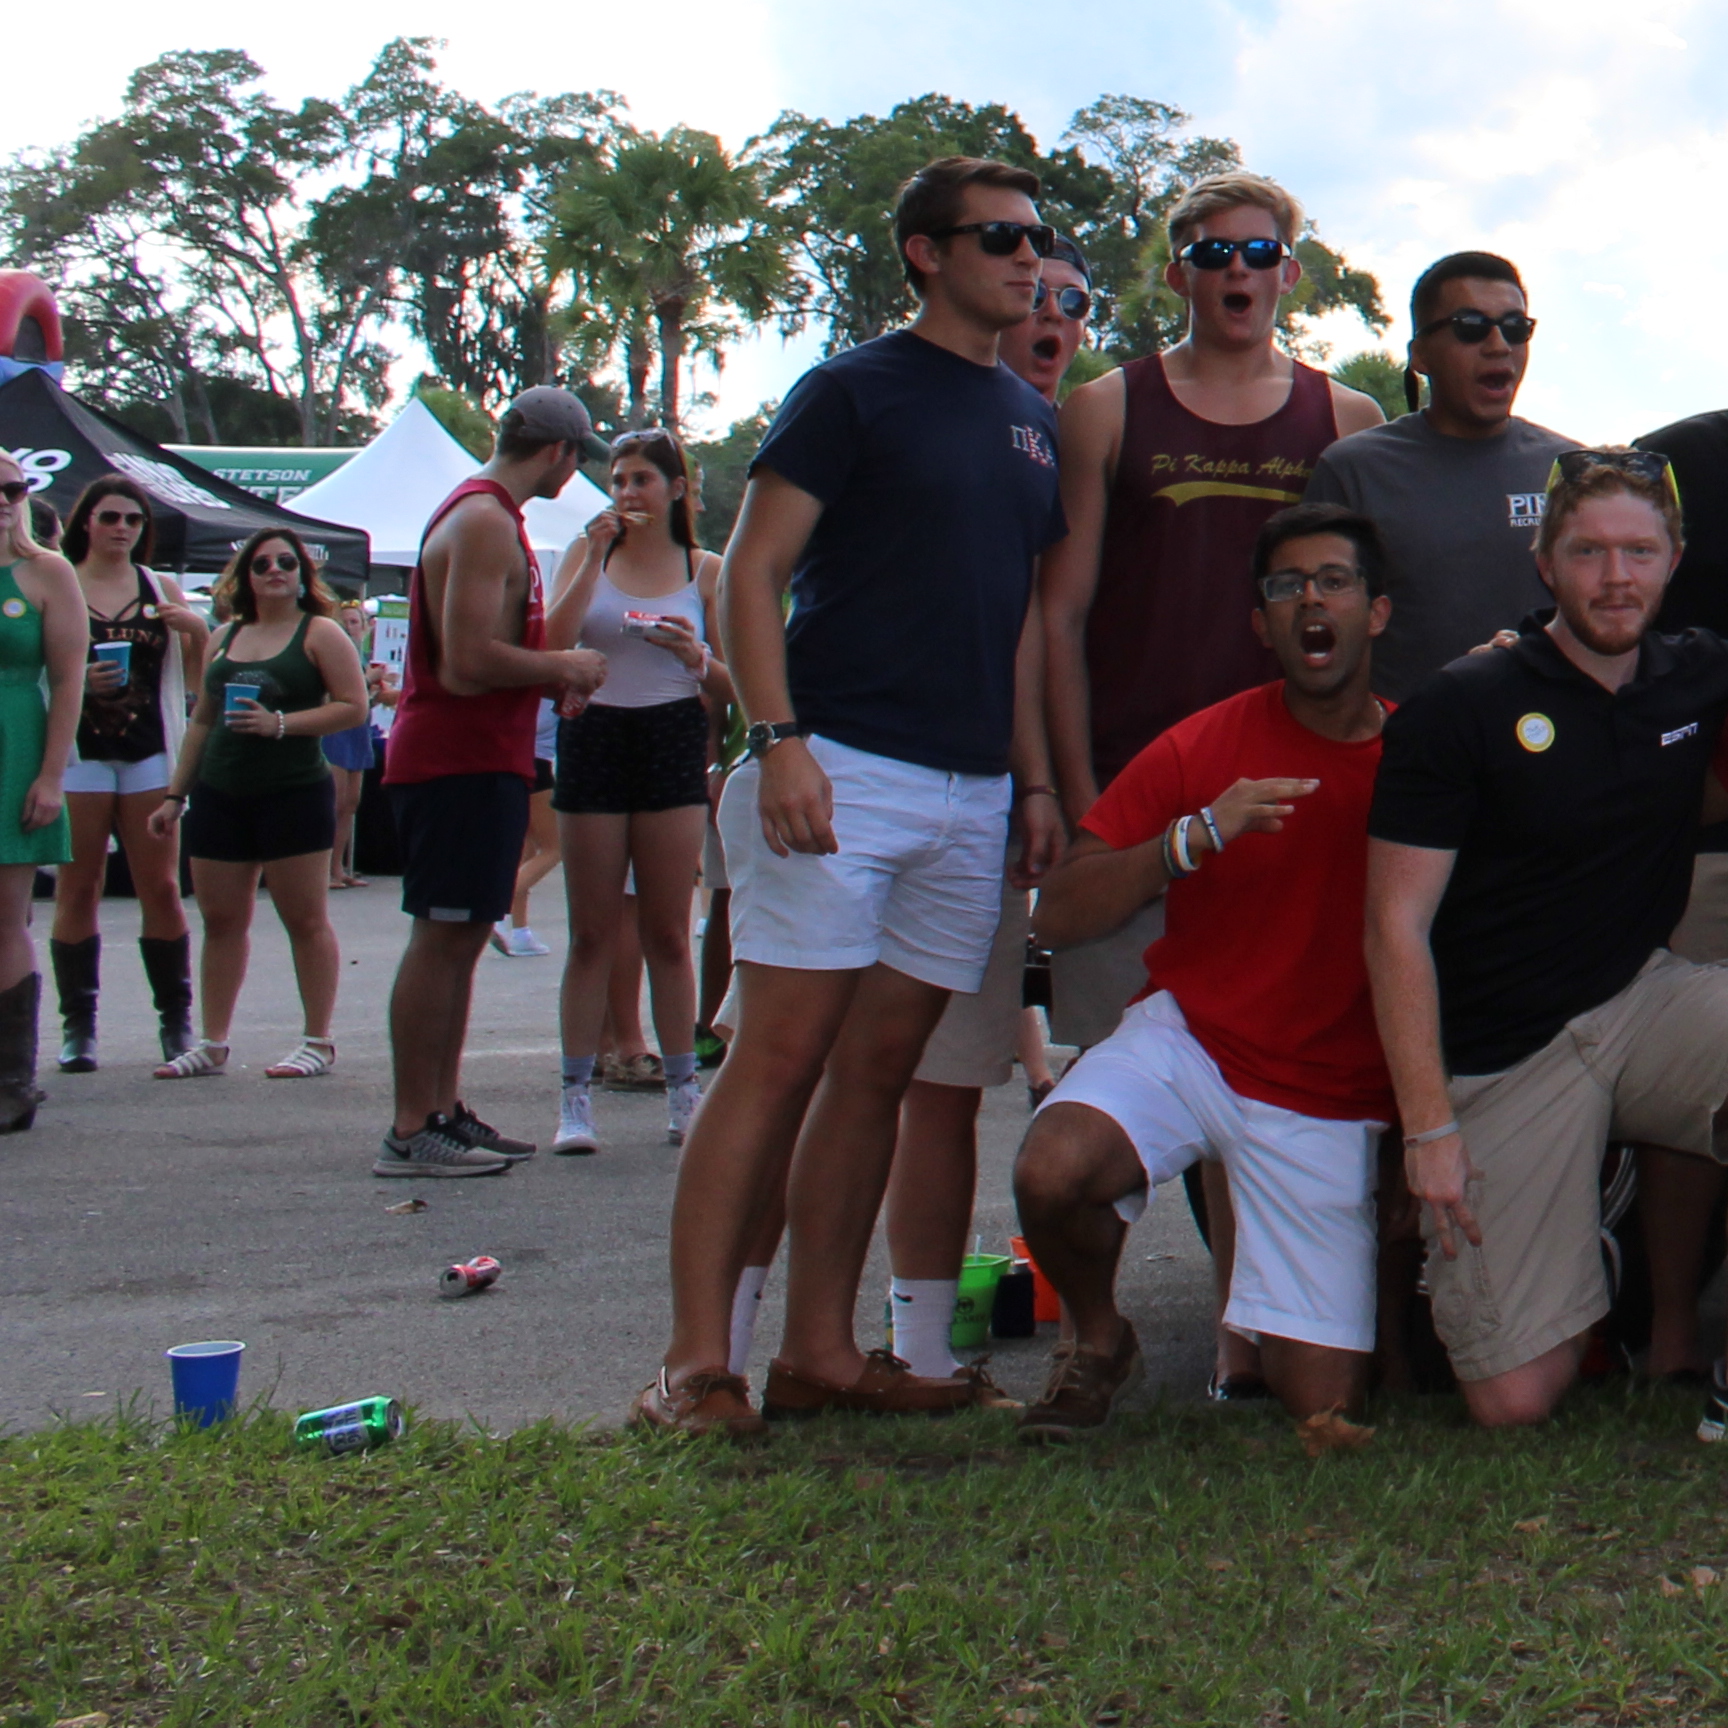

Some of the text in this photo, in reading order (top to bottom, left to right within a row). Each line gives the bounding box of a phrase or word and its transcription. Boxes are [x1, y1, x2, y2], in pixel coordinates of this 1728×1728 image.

[212, 468, 312, 482] STETSON
[1152, 454, 1175, 474] Pi
[1183, 454, 1250, 477] Kappa
[1660, 722, 1698, 747] ESPN
